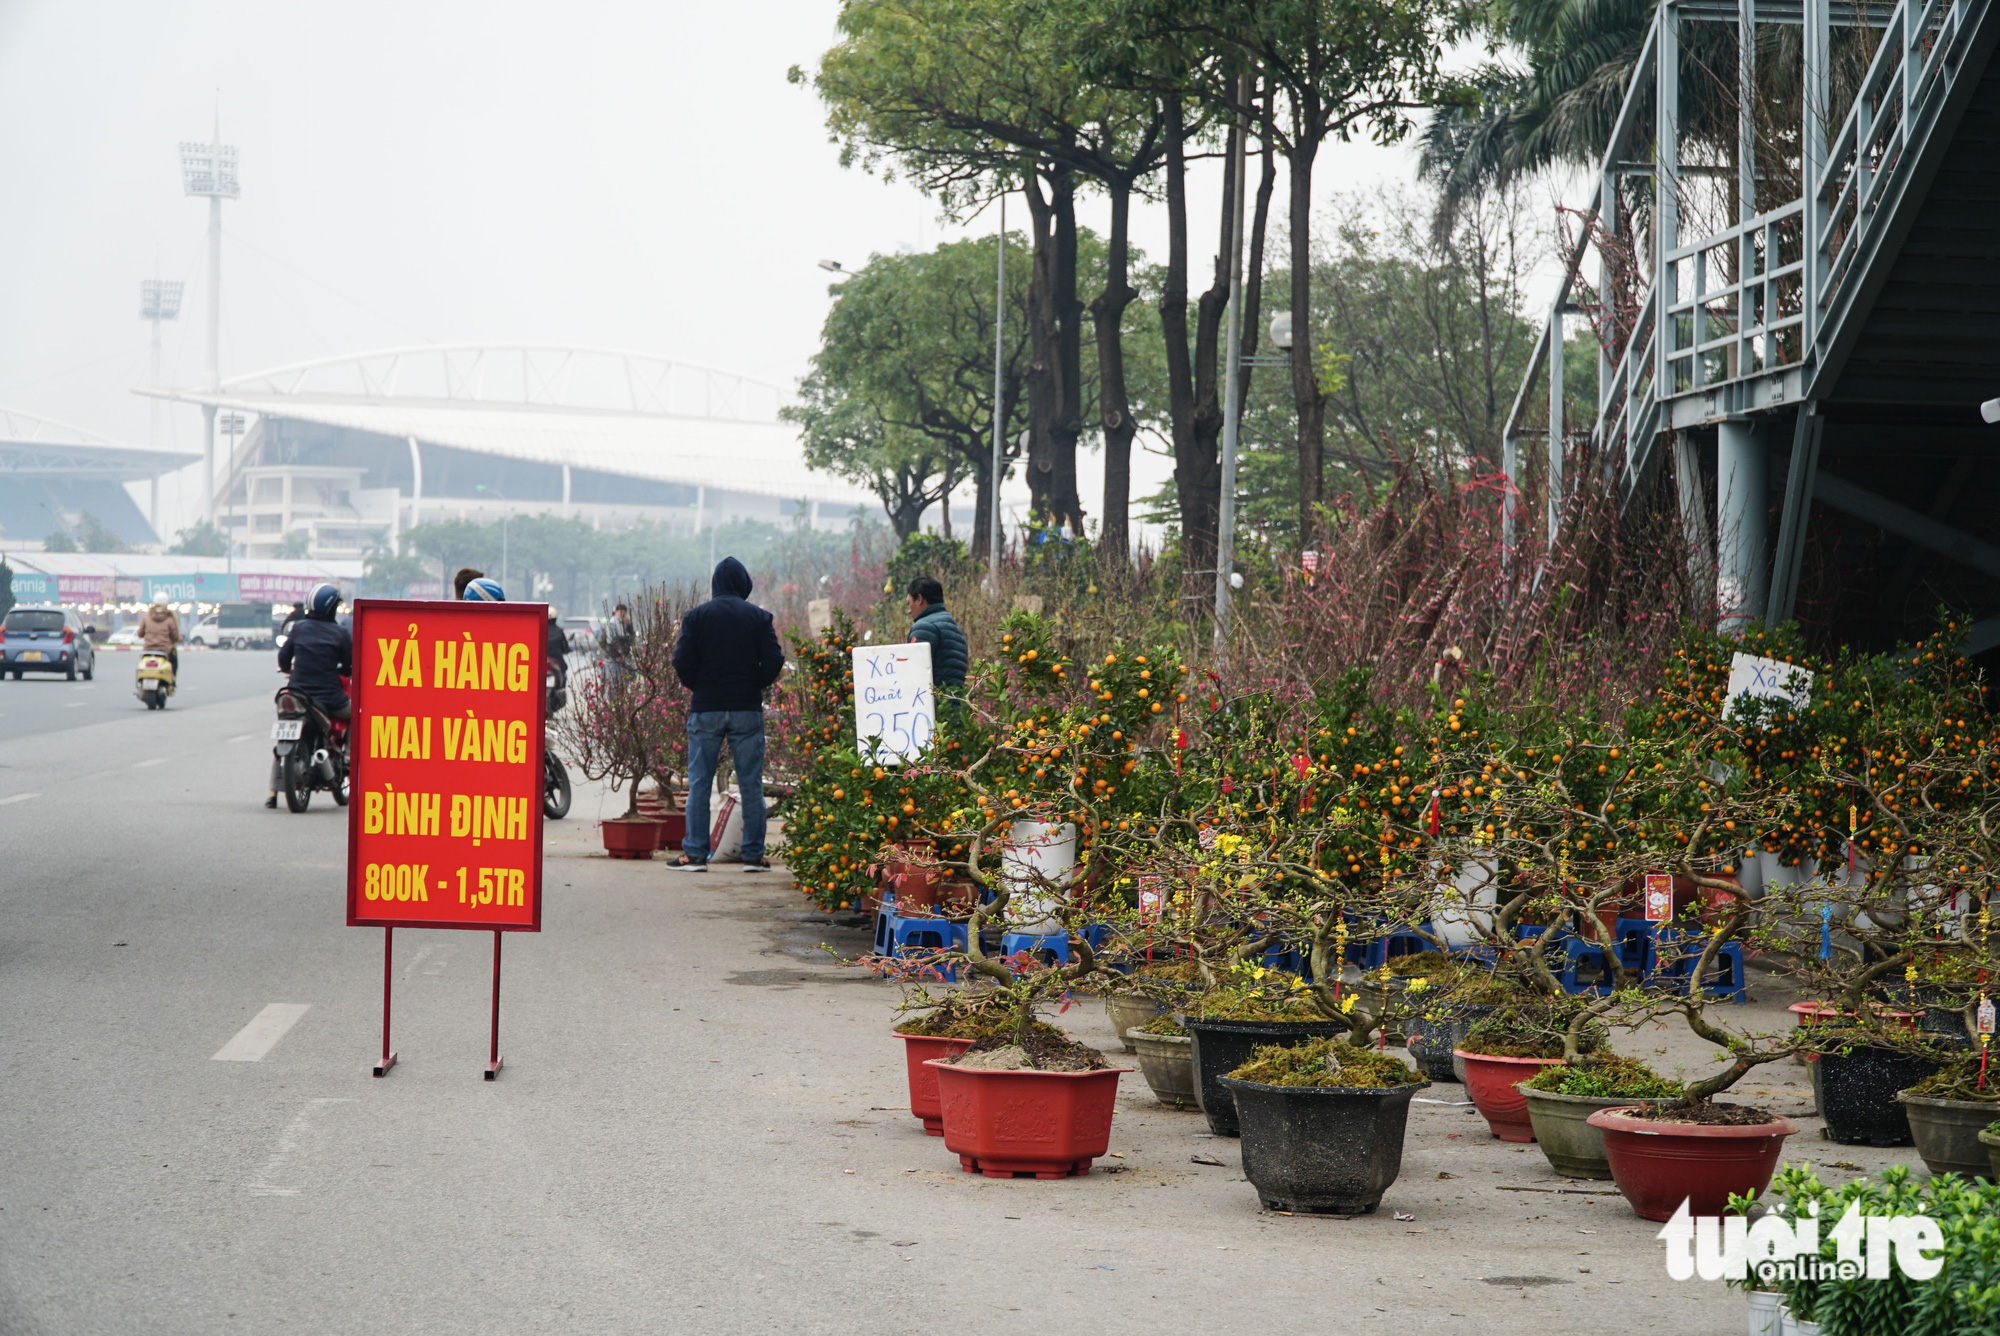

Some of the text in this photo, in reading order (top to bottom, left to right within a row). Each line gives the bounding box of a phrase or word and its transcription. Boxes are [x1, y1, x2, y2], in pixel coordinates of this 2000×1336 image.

[375, 623, 530, 692] XẢ HÀNG
[866, 653, 897, 679] Xả
[370, 709, 528, 764] MAI VÀNG
[864, 711, 932, 756] 250
[364, 783, 528, 847] BÌNH ĐỊNH
[364, 863, 525, 909] 800K - 1,5TR
